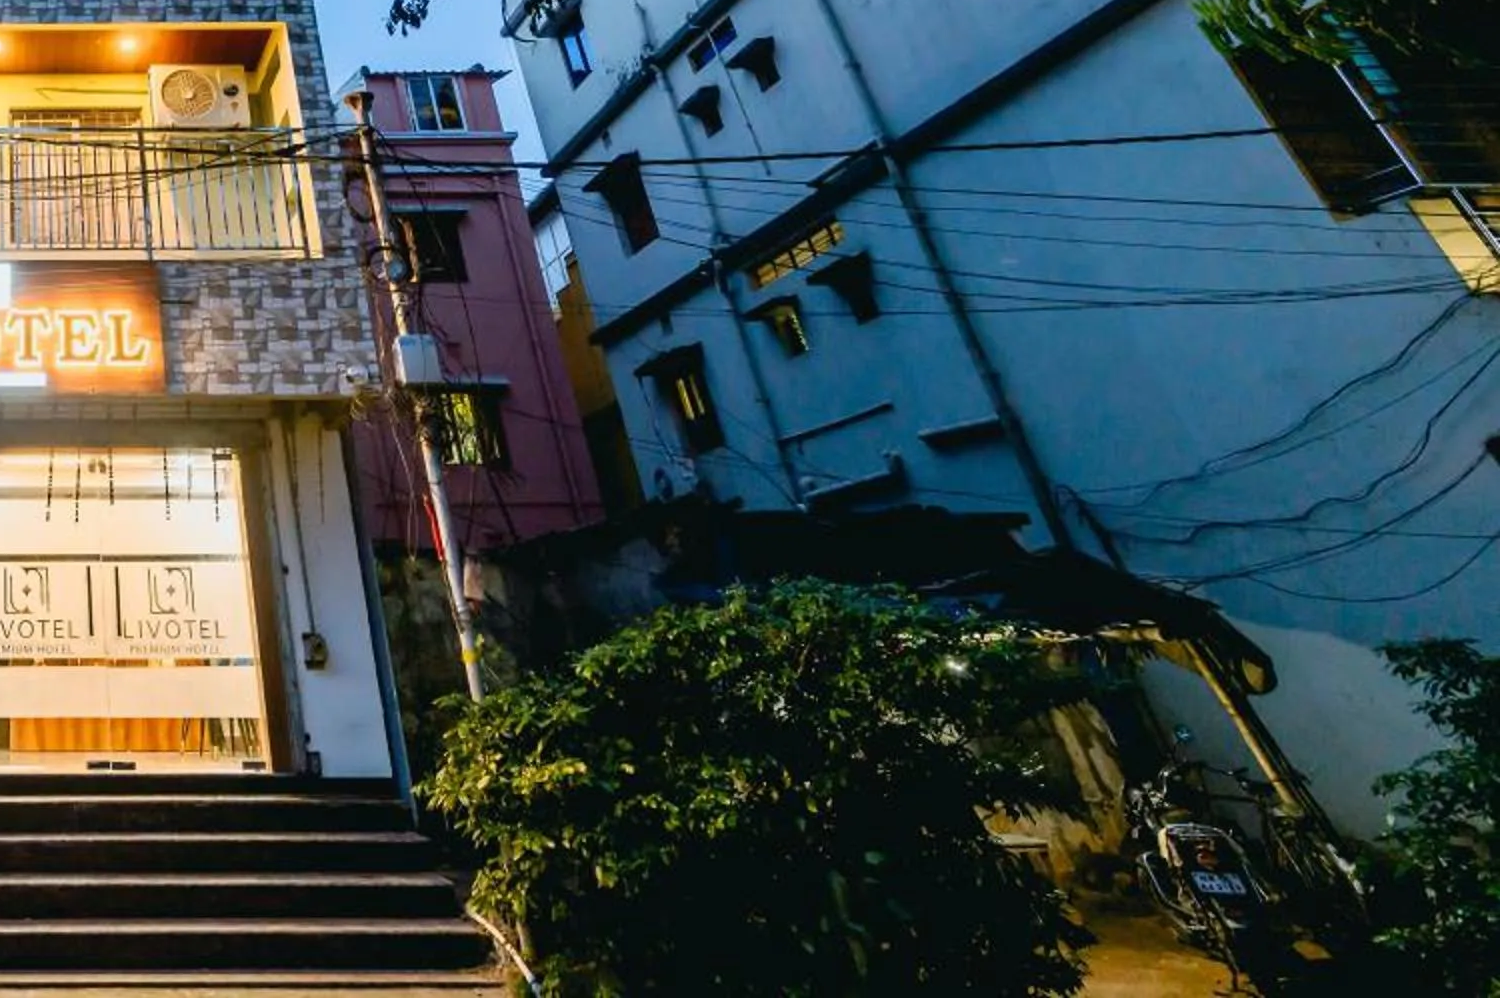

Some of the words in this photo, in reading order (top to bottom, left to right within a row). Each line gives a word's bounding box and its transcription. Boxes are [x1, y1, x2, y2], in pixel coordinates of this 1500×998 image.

[123, 619, 227, 639] LIVOTEL
[37, 643, 74, 654] HOTEL
[129, 643, 181, 654] PREMIUM
